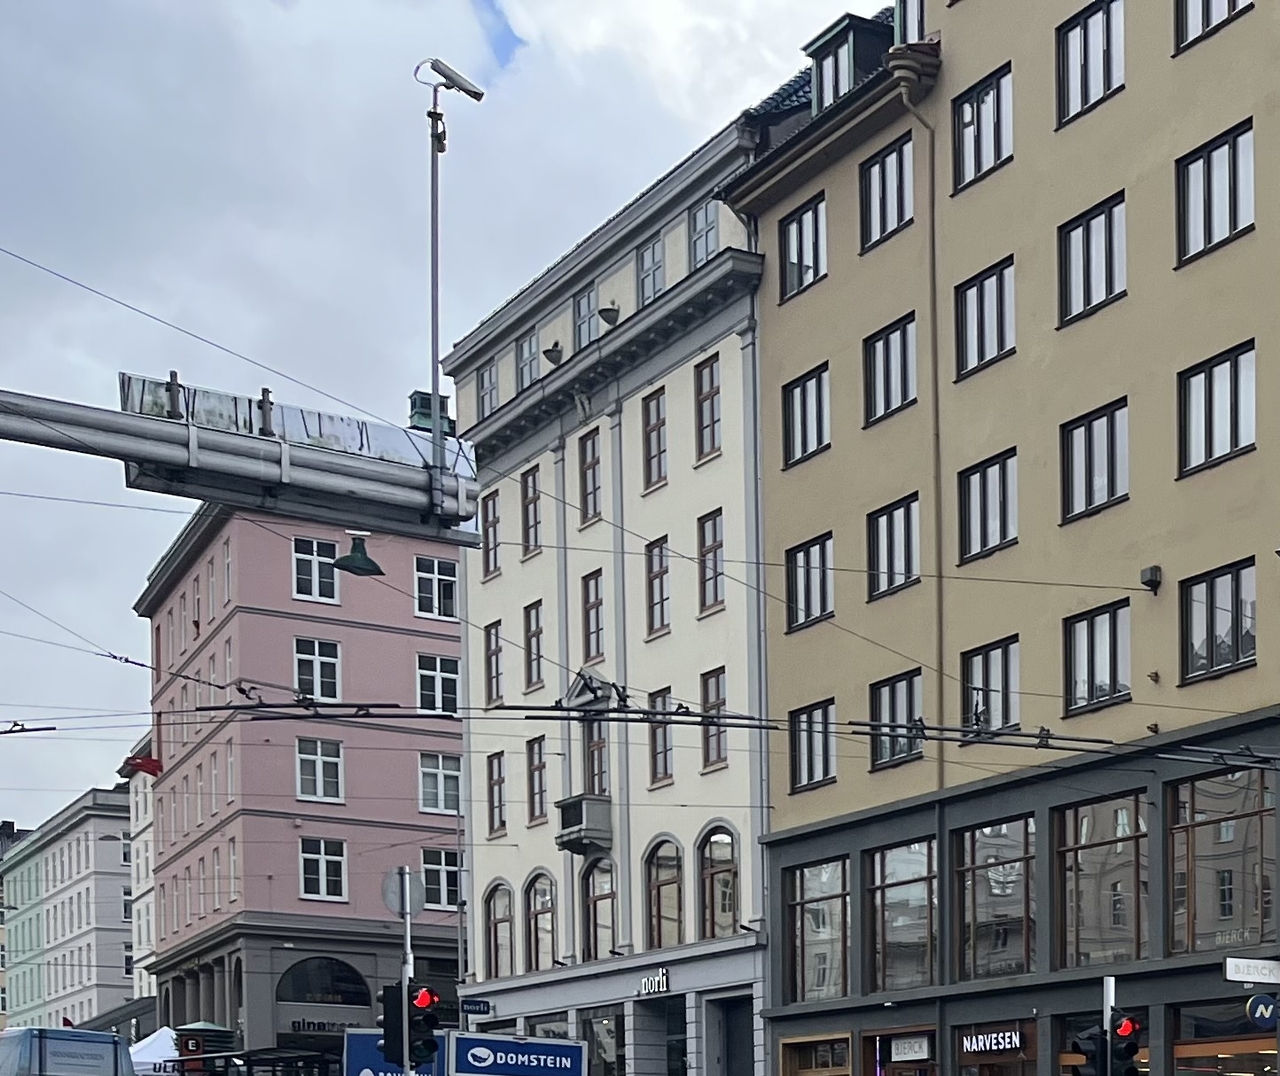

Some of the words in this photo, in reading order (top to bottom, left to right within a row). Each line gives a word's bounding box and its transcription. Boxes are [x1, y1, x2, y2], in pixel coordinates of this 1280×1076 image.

[1234, 963, 1276, 978] BJERCK
[641, 967, 670, 994] norli
[463, 1003, 488, 1013] norli
[187, 1040, 198, 1050] E
[894, 1040, 924, 1056] BJERCK
[962, 1031, 1021, 1053] NARVESEN
[497, 1052, 572, 1069] DOMSTEIN
